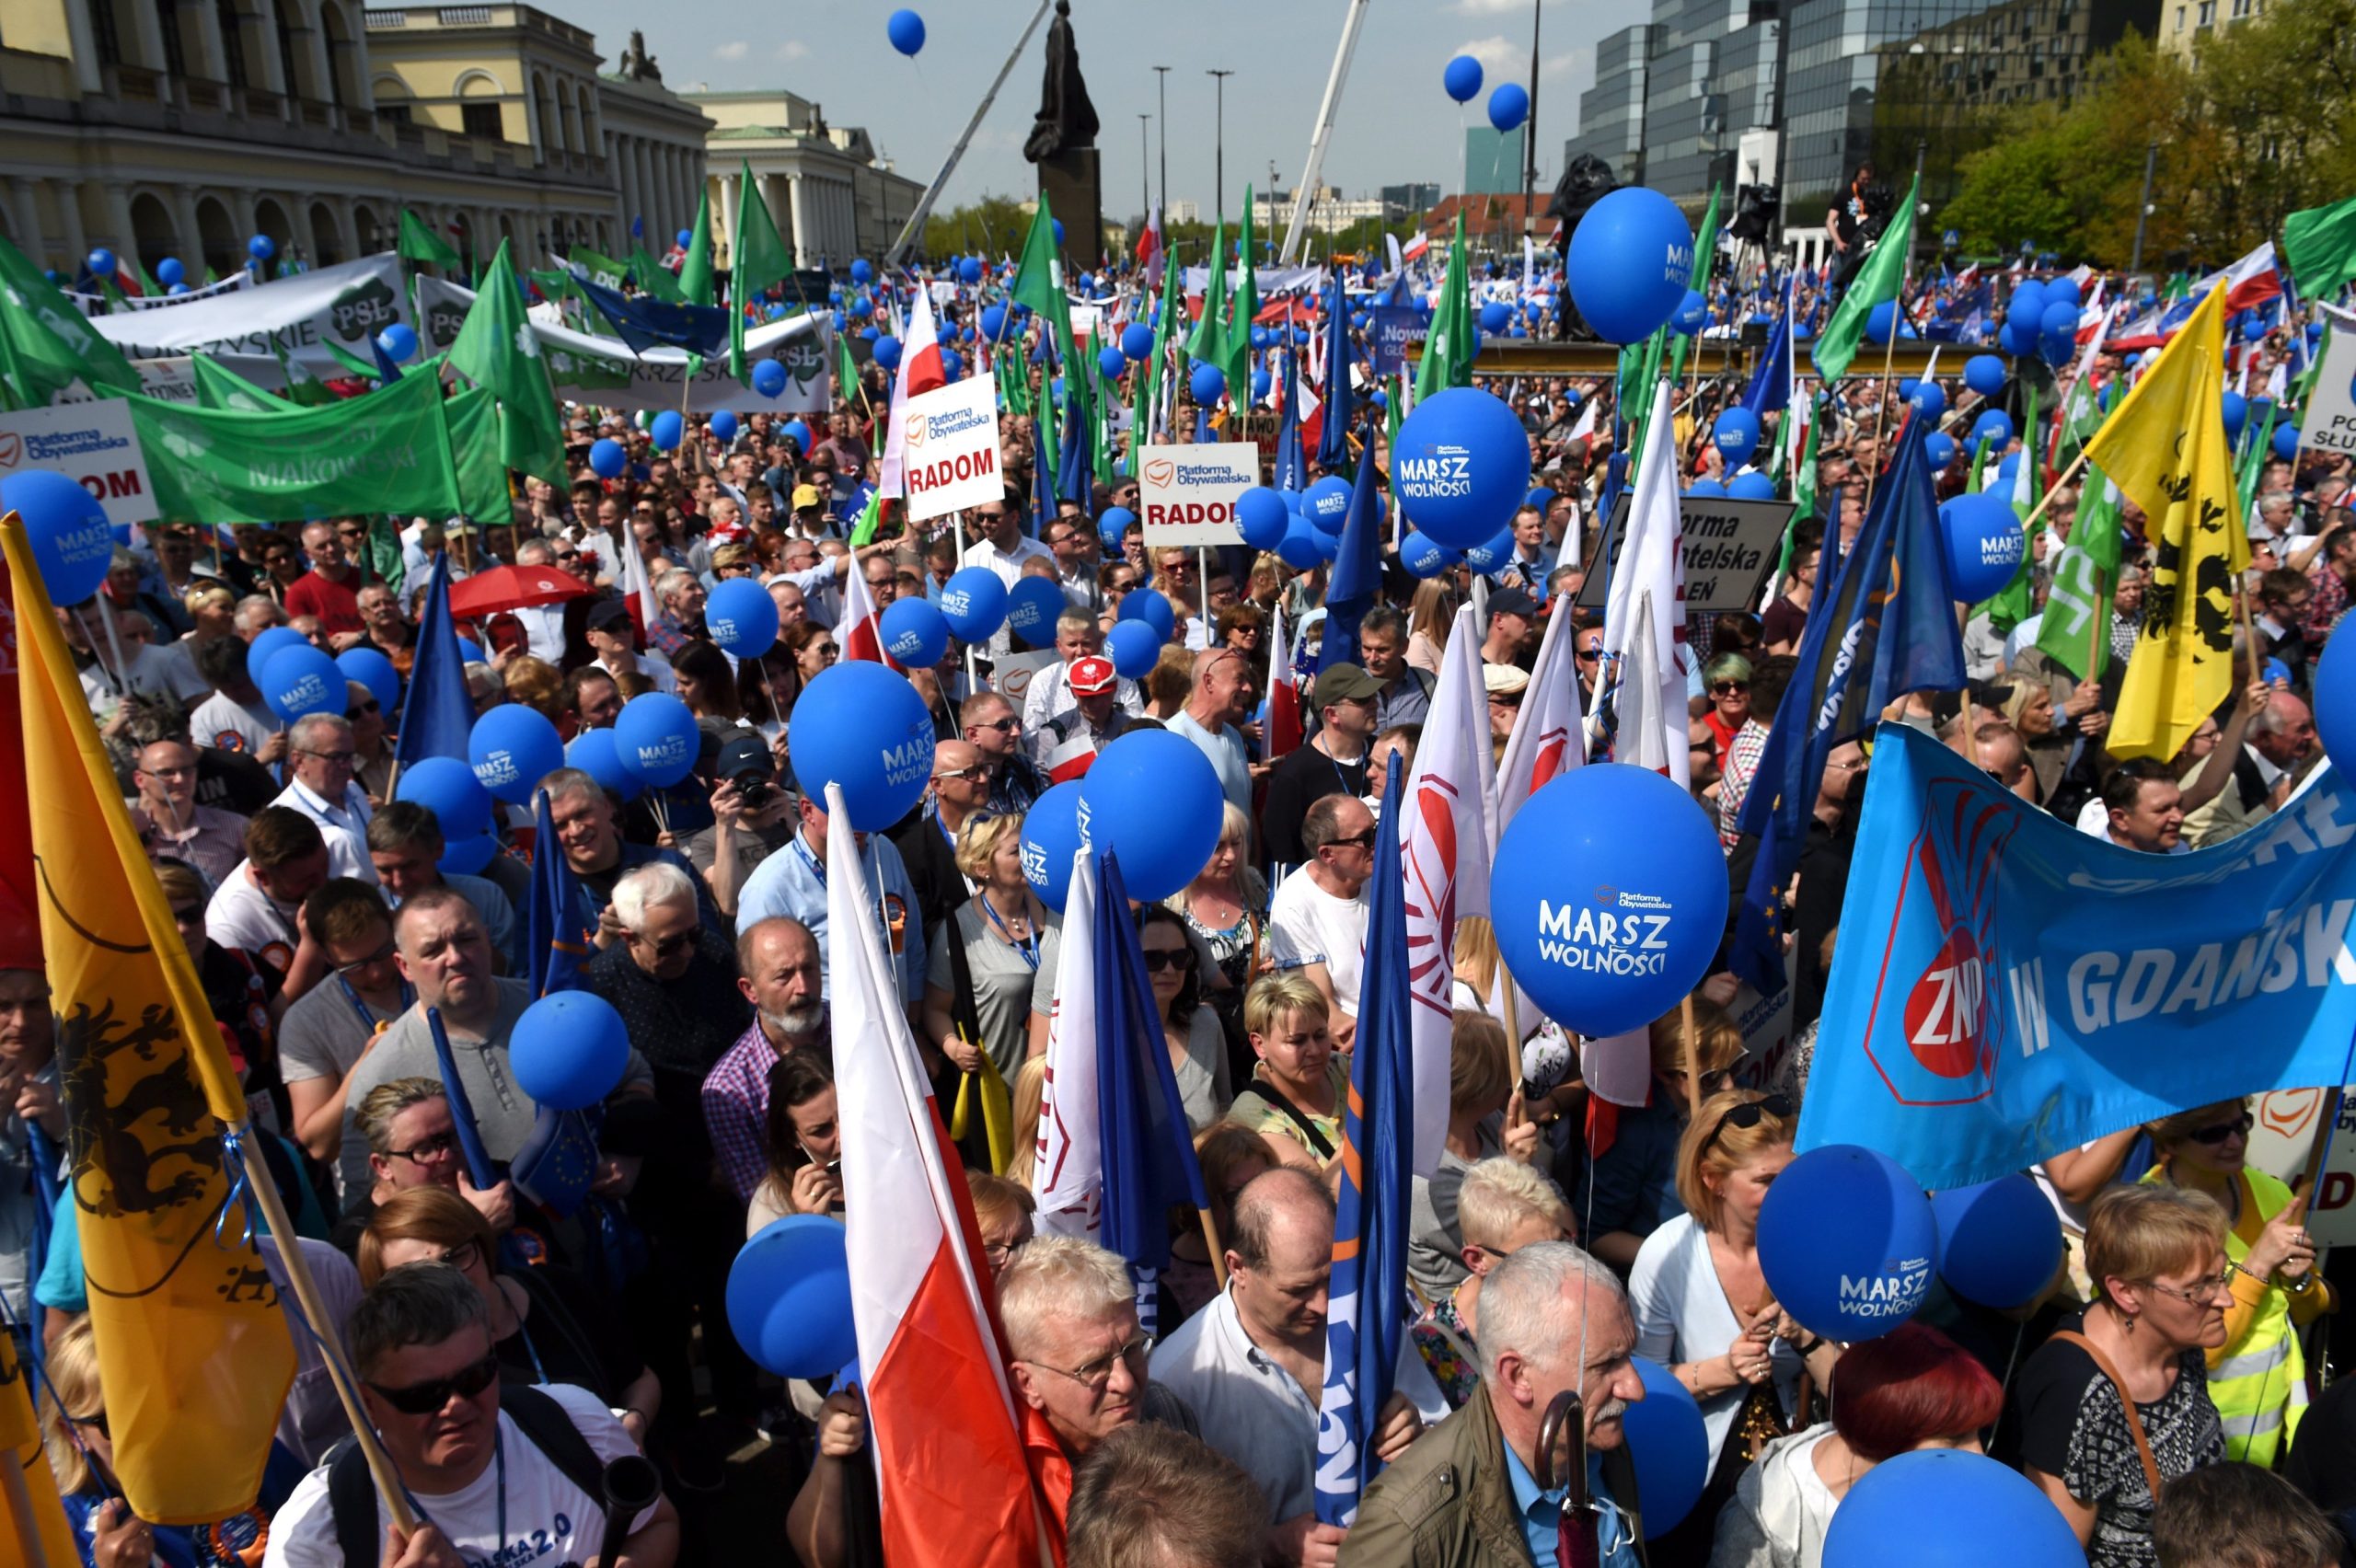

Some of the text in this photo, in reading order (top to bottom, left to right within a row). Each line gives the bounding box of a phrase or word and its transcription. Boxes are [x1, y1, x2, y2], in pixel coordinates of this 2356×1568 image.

[338, 295, 391, 330] PSL
[433, 313, 464, 335] PS
[928, 407, 973, 428] Platforma
[929, 413, 990, 440] Obywatelska
[25, 428, 101, 447] Platforma
[28, 436, 130, 461] Obywatelska
[908, 447, 994, 494] RADOM
[1176, 464, 1231, 476] Platforma
[1400, 456, 1470, 481] MARSZ
[1177, 474, 1251, 488] Obywatelska
[1403, 478, 1471, 498] WOLNOŚCI
[1316, 496, 1345, 509] MARSZ
[55, 523, 110, 553] MARSZ
[1981, 536, 2024, 554] MARSZ
[941, 591, 971, 609] MARSZ
[1010, 605, 1039, 621] MARSZ
[888, 632, 920, 655] MARSZ
[279, 677, 321, 707] MARSZ
[638, 739, 687, 760] MARSZ
[1618, 899, 1672, 910] Obywatelska
[1619, 891, 1661, 903] Platforma
[1539, 899, 1671, 949] MARSZ
[1538, 938, 1667, 977] WOLNOŚCI
[1911, 955, 1983, 1046] ZNP
[2008, 957, 2050, 1058] W
[1840, 1269, 1929, 1301] MARSZ
[530, 1512, 572, 1557] 2.0
